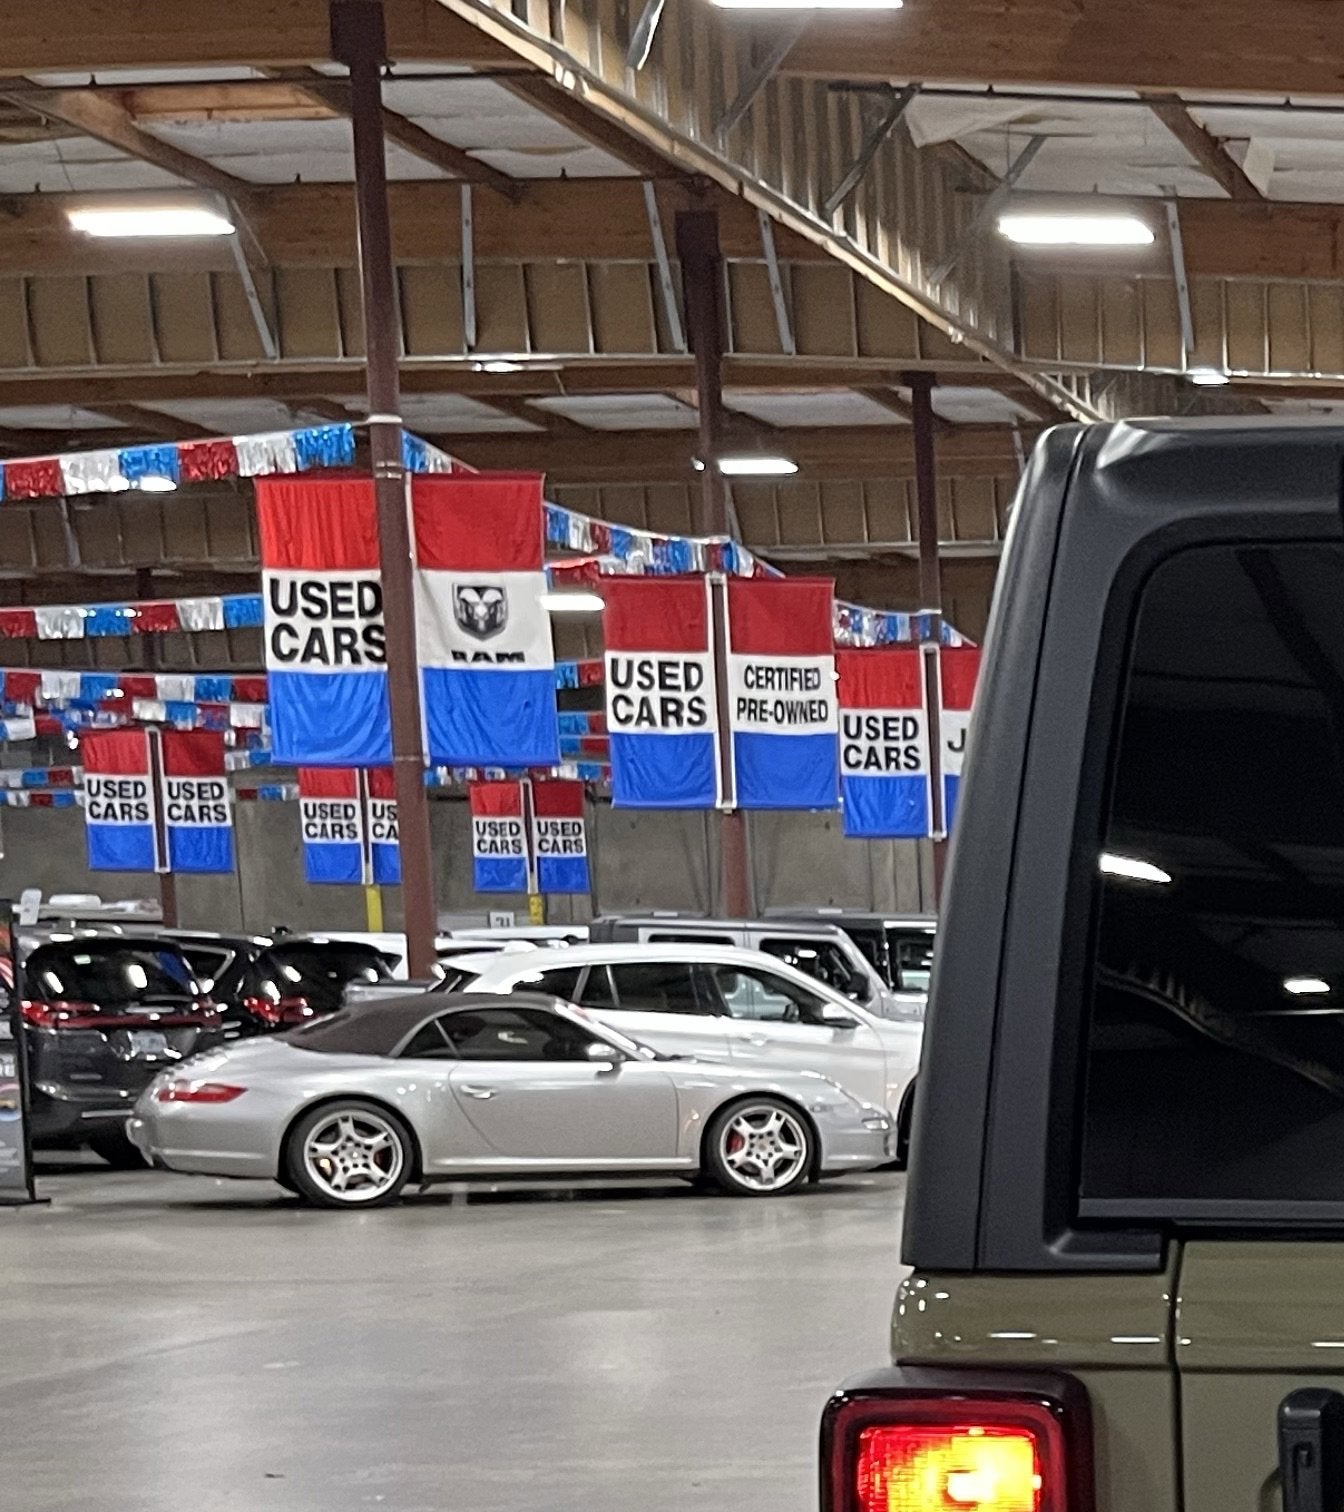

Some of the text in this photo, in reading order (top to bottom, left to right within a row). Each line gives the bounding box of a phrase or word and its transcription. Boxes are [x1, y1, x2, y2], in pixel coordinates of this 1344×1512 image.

[269, 578, 383, 620] USED
[271, 622, 386, 665] CARS
[610, 658, 703, 692] USED
[744, 665, 821, 691] CERTIFIED
[612, 694, 707, 727] CARS
[737, 697, 829, 725] PRE-OWNED
[843, 715, 919, 741] USED
[843, 745, 921, 770] CARS
[87, 779, 147, 800] USED
[167, 781, 225, 801] USED
[88, 802, 150, 822] CARS
[167, 803, 228, 823] CARS
[303, 803, 356, 821] USED
[305, 823, 358, 840] CARS
[475, 821, 520, 837] USED
[537, 821, 582, 837] USED
[476, 838, 522, 854] CARS
[538, 838, 584, 854] CARS
